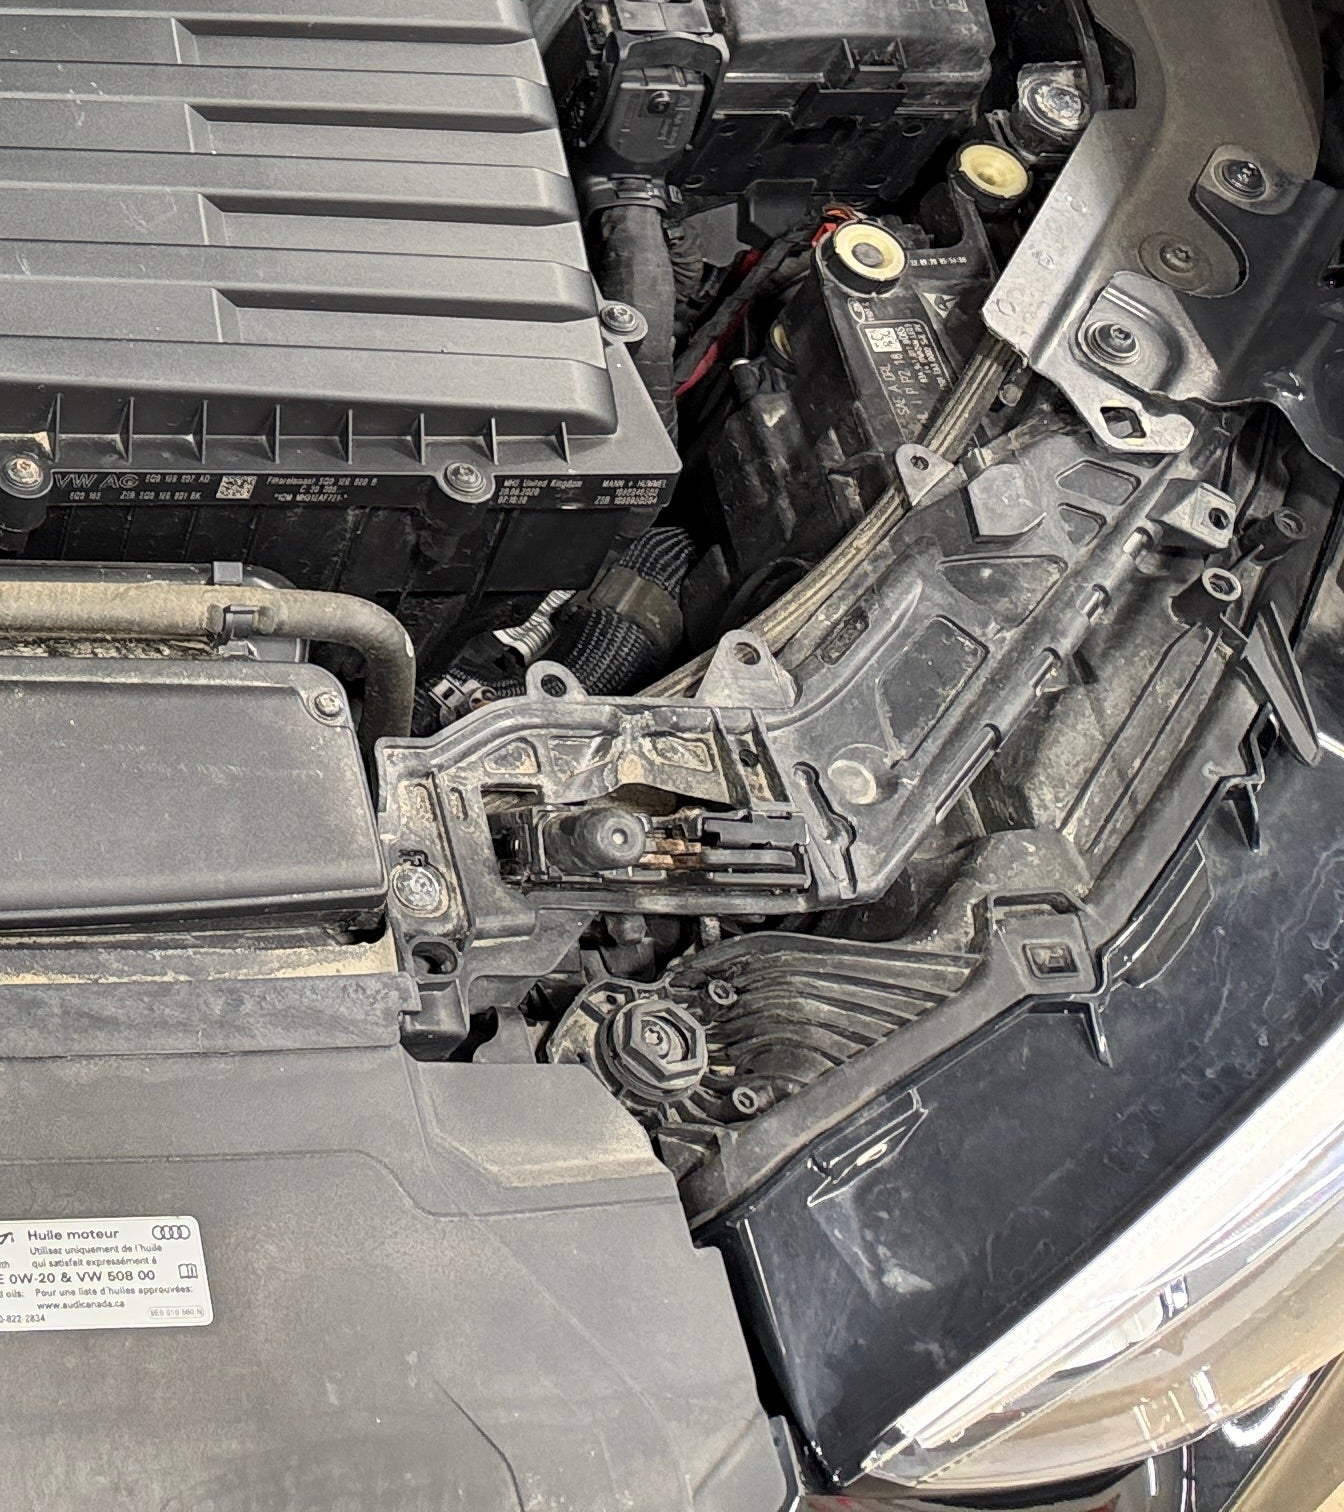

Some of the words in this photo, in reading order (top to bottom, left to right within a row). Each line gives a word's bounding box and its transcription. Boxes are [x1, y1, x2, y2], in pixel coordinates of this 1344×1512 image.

[54, 473, 98, 488] VW
[99, 473, 140, 488] AG
[27, 1229, 63, 1241] Huile
[66, 1229, 120, 1240] moteur
[31, 1259, 47, 1269] qui
[8, 1272, 57, 1285] 0W-20
[60, 1271, 72, 1283] &
[75, 1271, 104, 1283] VW
[107, 1270, 134, 1282] 508
[137, 1269, 157, 1281] 00
[35, 1287, 57, 1297] Pour
